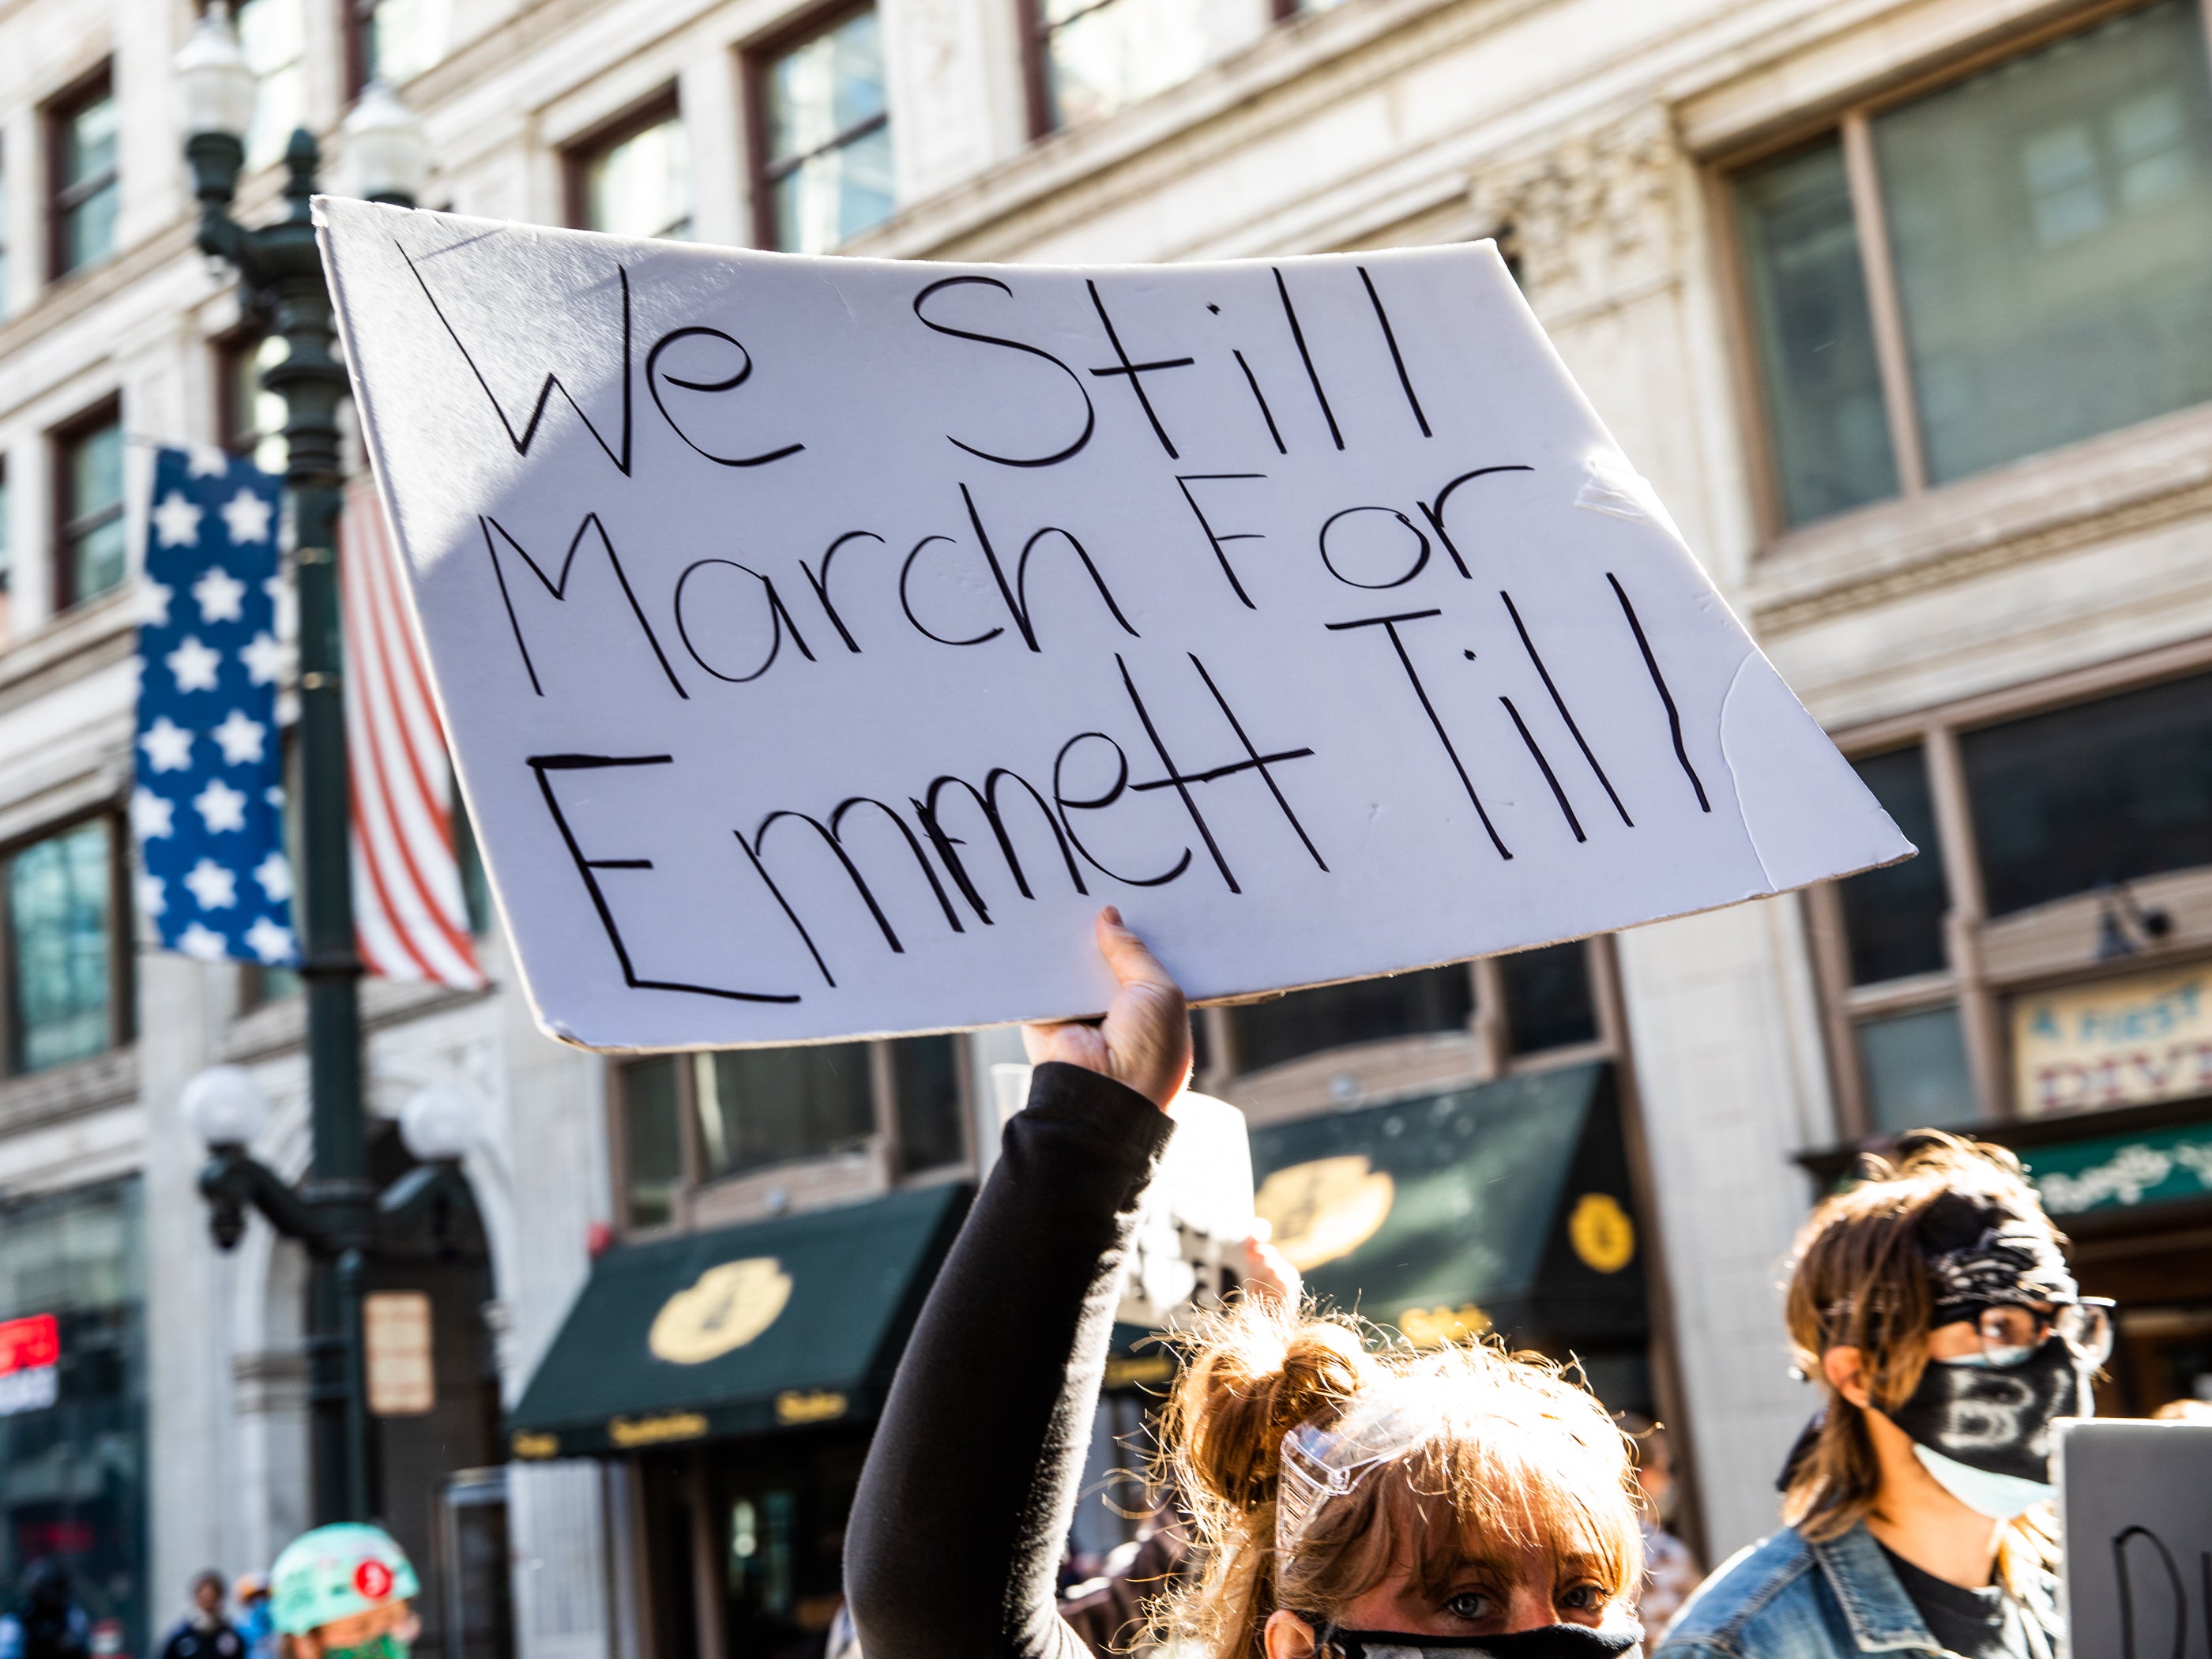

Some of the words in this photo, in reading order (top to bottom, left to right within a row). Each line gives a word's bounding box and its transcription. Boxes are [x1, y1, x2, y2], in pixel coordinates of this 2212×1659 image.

[393, 239, 807, 479] We
[912, 266, 1433, 468] Still
[478, 482, 1142, 700] March
[1175, 465, 1535, 611] For
[525, 651, 1330, 1005] Emmett
[1324, 572, 1712, 861] Till
